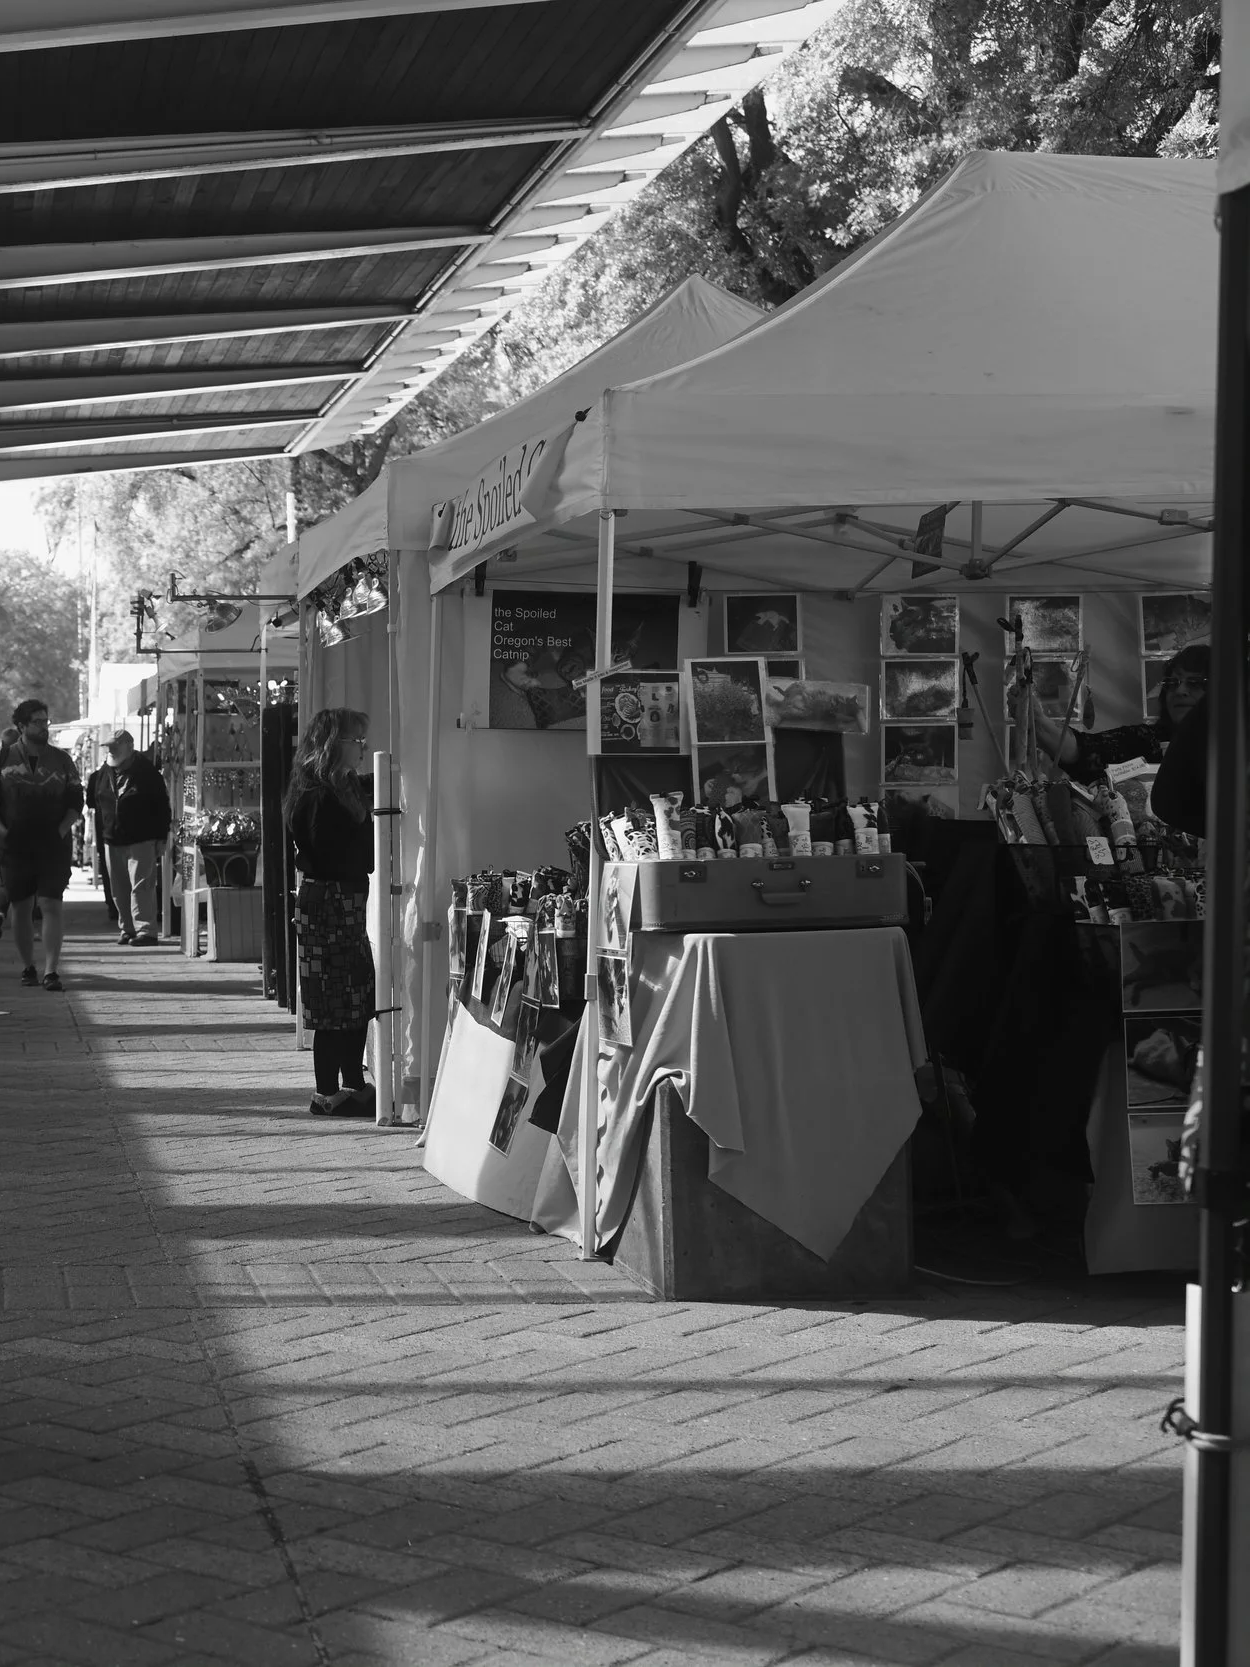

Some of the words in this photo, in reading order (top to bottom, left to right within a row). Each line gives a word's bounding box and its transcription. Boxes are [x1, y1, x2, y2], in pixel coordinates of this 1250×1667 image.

[474, 444, 527, 551] Spoiled
[494, 607, 512, 618] the
[515, 607, 557, 620] Spoiled
[494, 620, 514, 632] Cat
[493, 634, 544, 648] Oregon's
[547, 636, 572, 647] Best
[493, 648, 530, 661] Catnip
